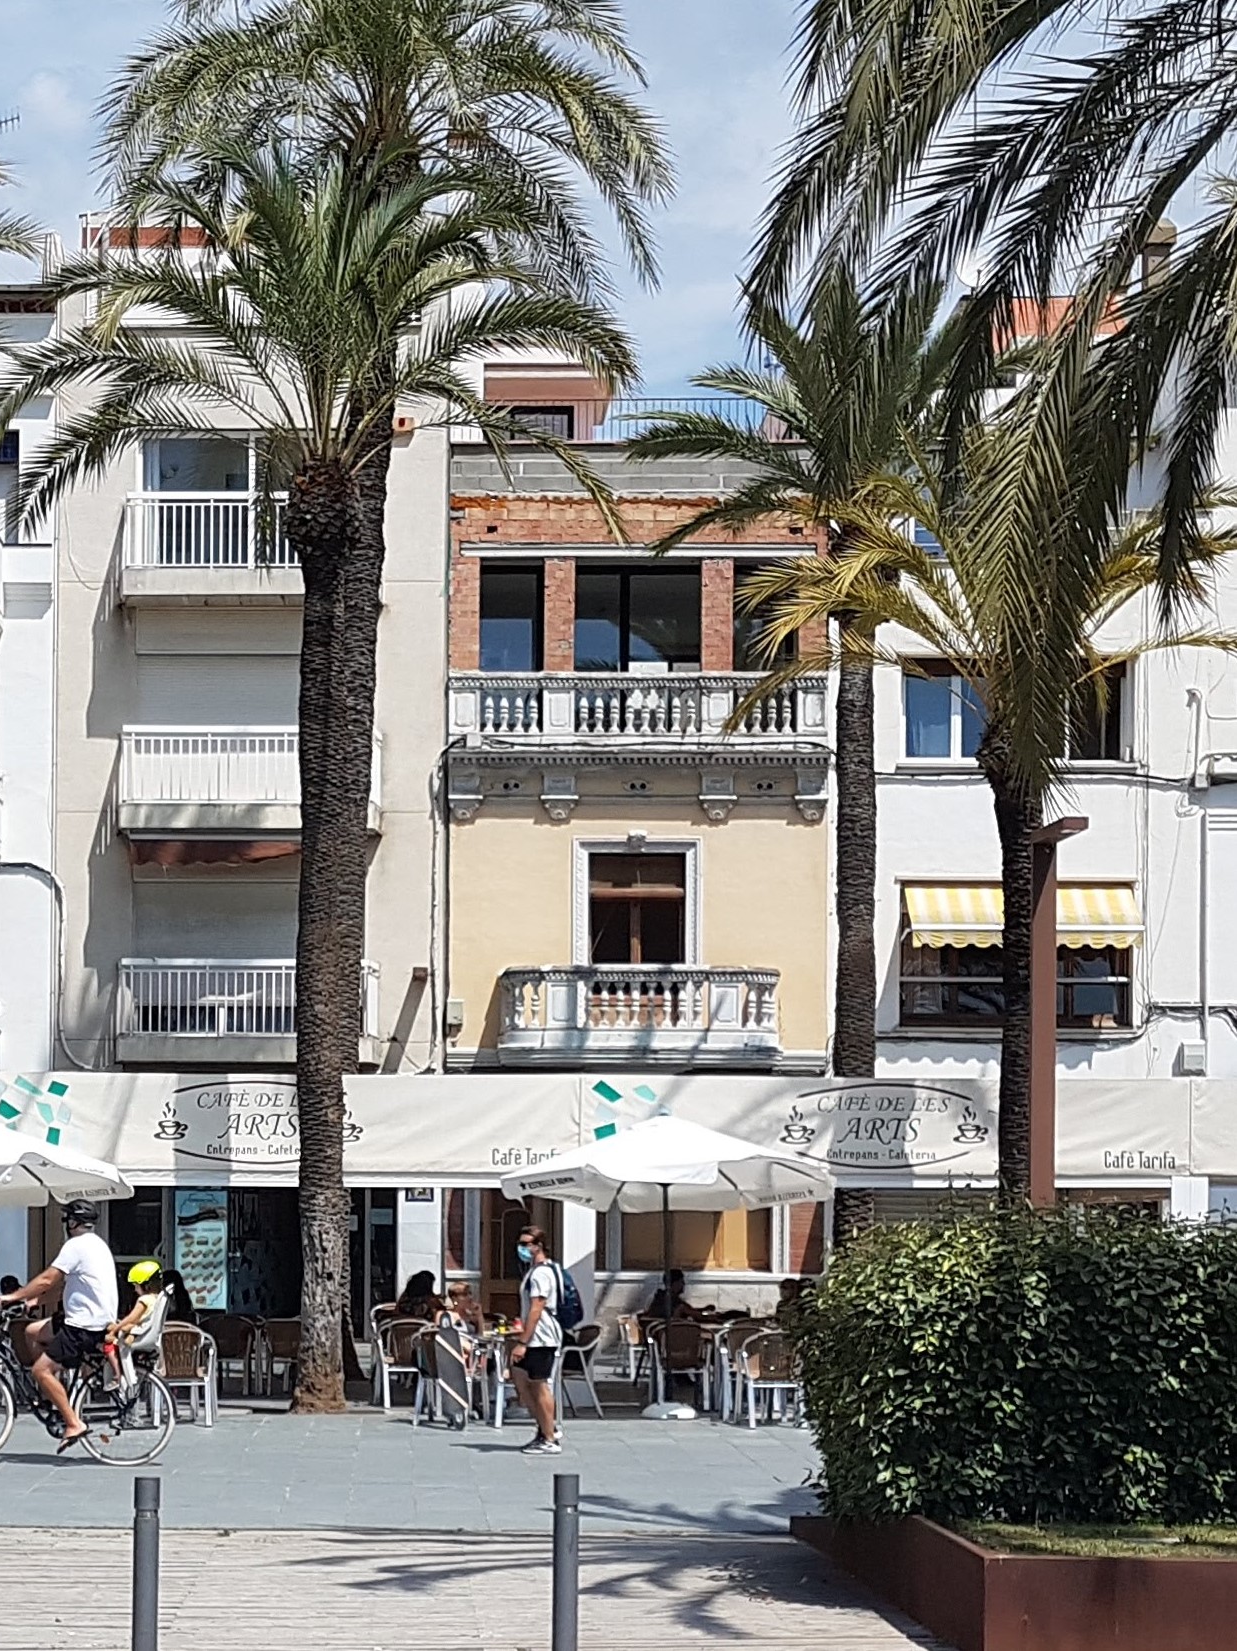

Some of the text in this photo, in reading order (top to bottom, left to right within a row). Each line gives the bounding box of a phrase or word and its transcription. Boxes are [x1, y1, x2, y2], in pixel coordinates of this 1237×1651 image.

[197, 1089, 250, 1109] CAFÈ
[254, 1092, 284, 1108] DE
[817, 1093, 952, 1113] CAFÈ DE LES
[217, 1111, 300, 1141] ARTS
[837, 1114, 922, 1146] ARTS
[206, 1143, 300, 1157] Entrepans Cafete
[525, 1147, 561, 1166] Tarif
[827, 1149, 936, 1162] Entrepans Cafeteria
[1137, 1150, 1176, 1170] Tarifa
